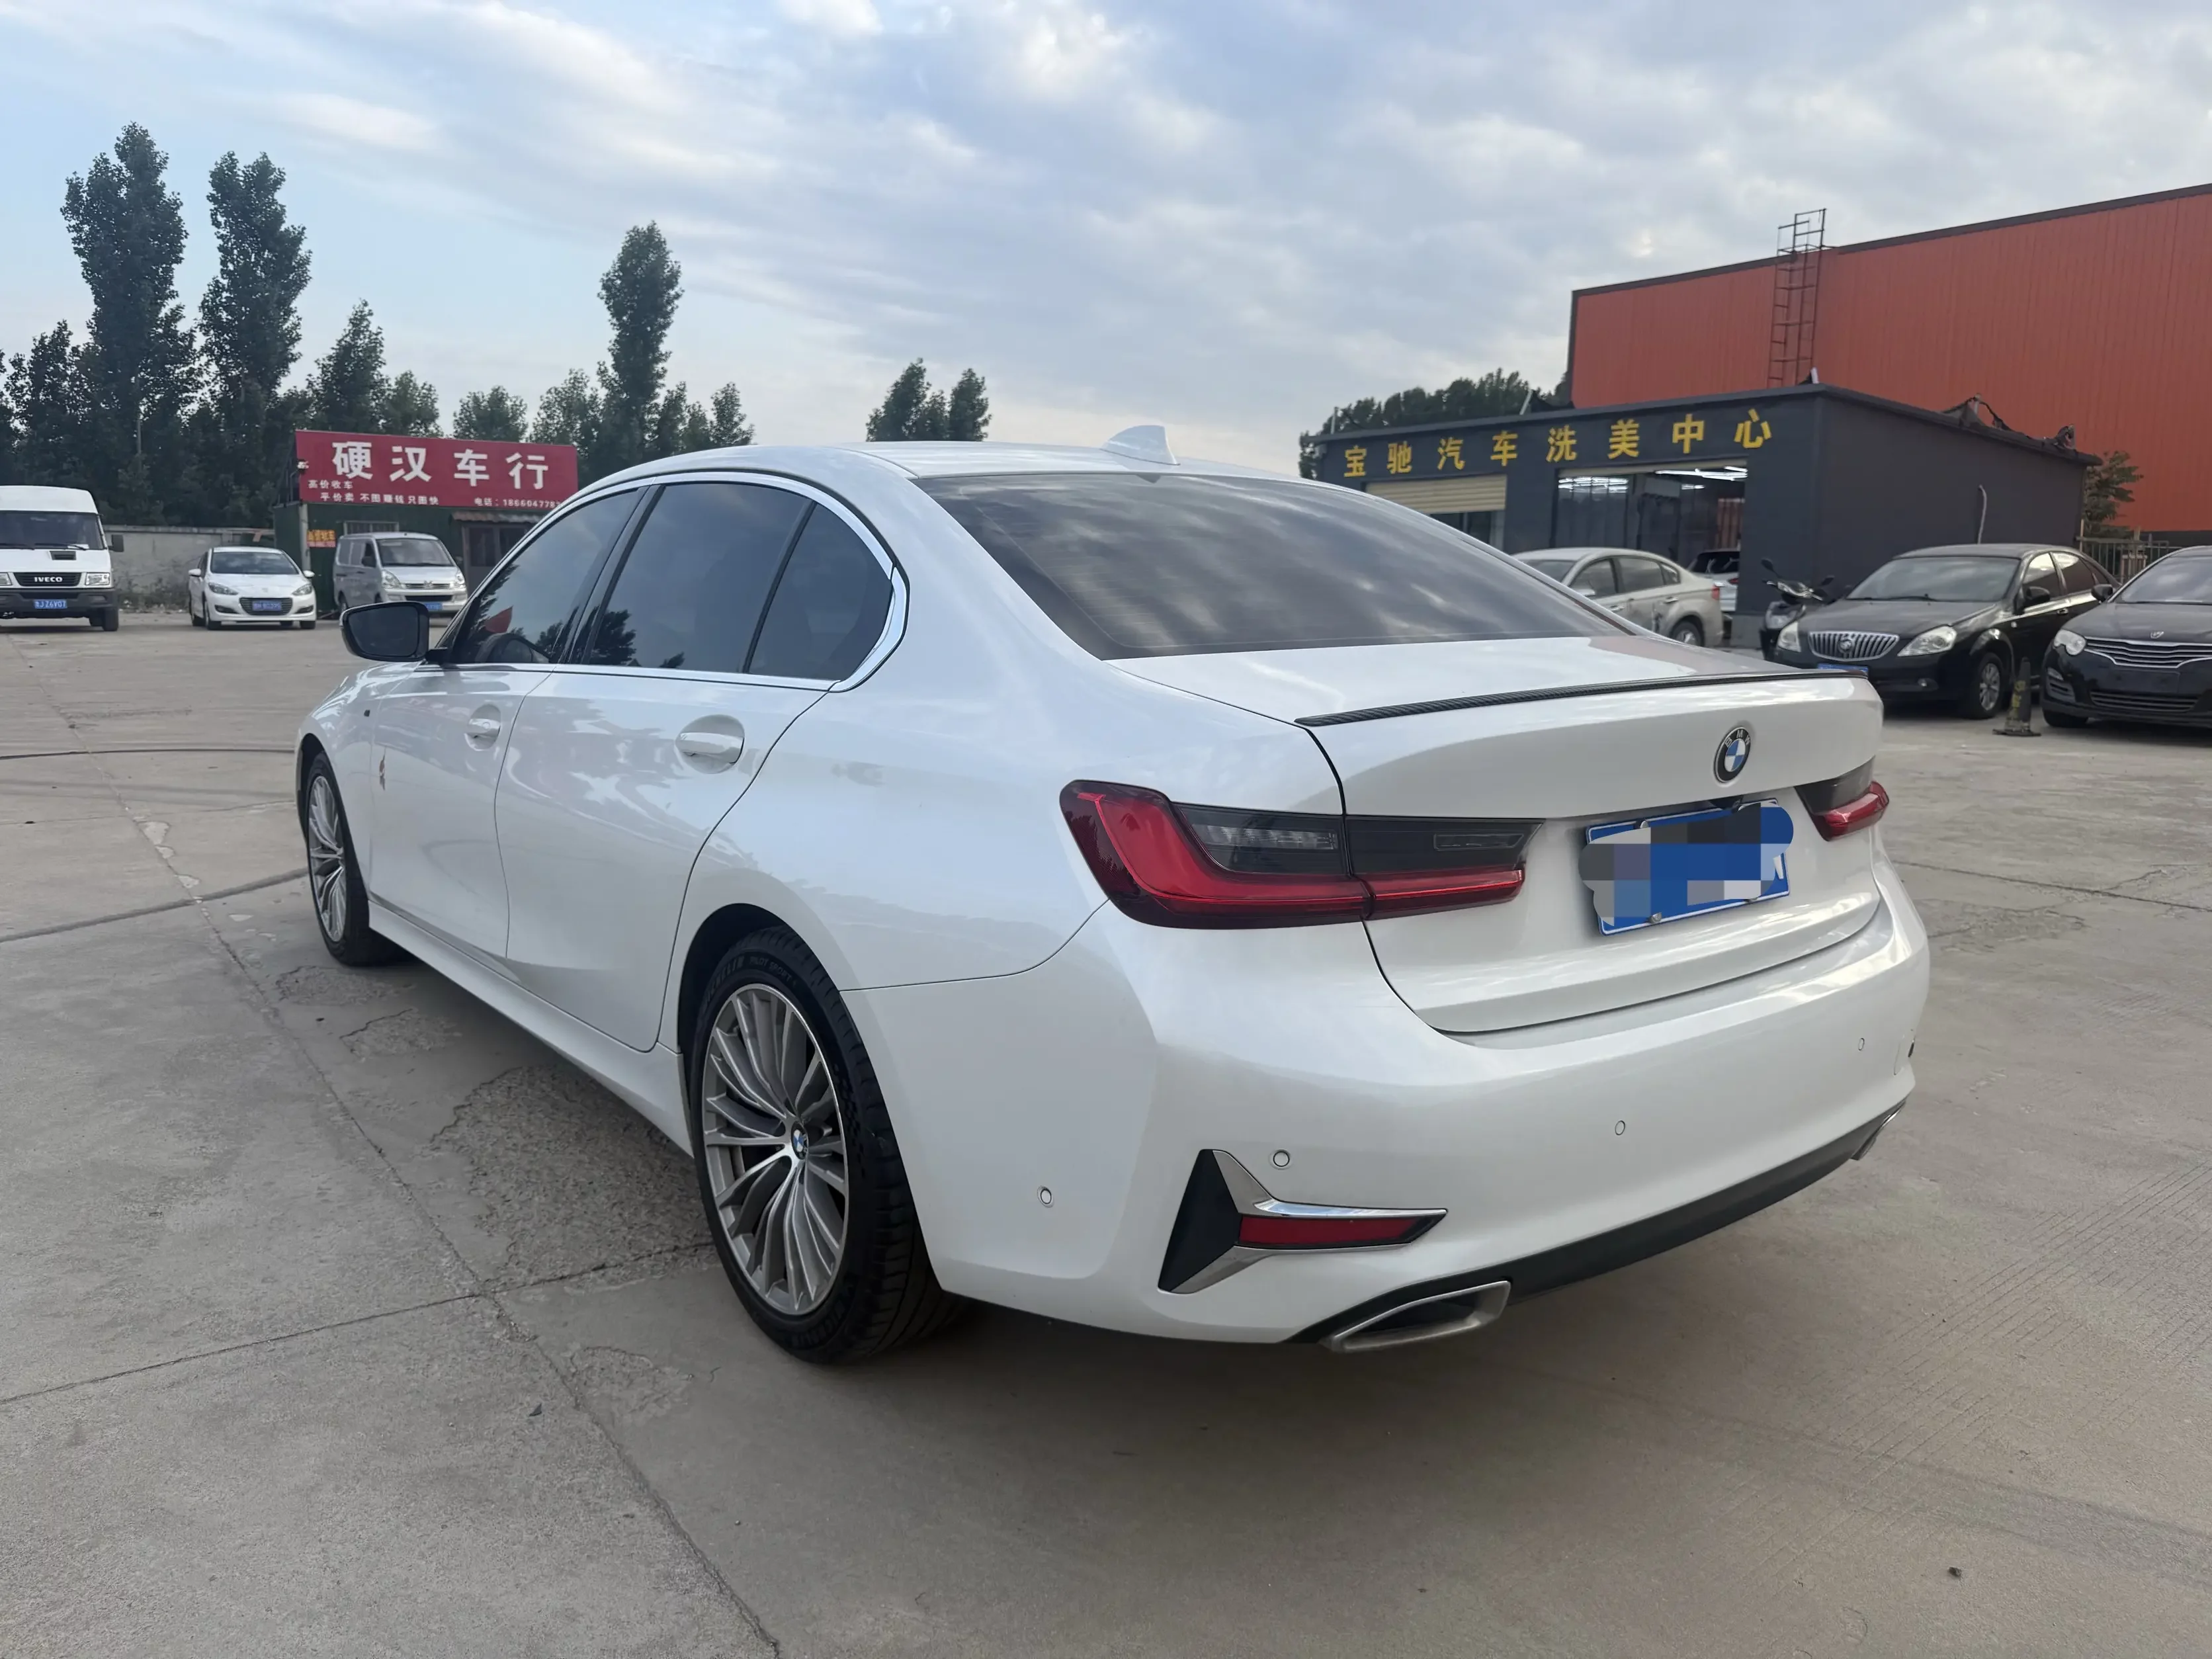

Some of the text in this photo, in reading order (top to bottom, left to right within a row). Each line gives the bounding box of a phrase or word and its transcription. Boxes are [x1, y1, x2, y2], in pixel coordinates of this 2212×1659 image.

[332, 441, 548, 489] 硬汉车行
[1343, 408, 1772, 478] 宝驰汽车洗美中心
[1724, 730, 1750, 747] BMW
